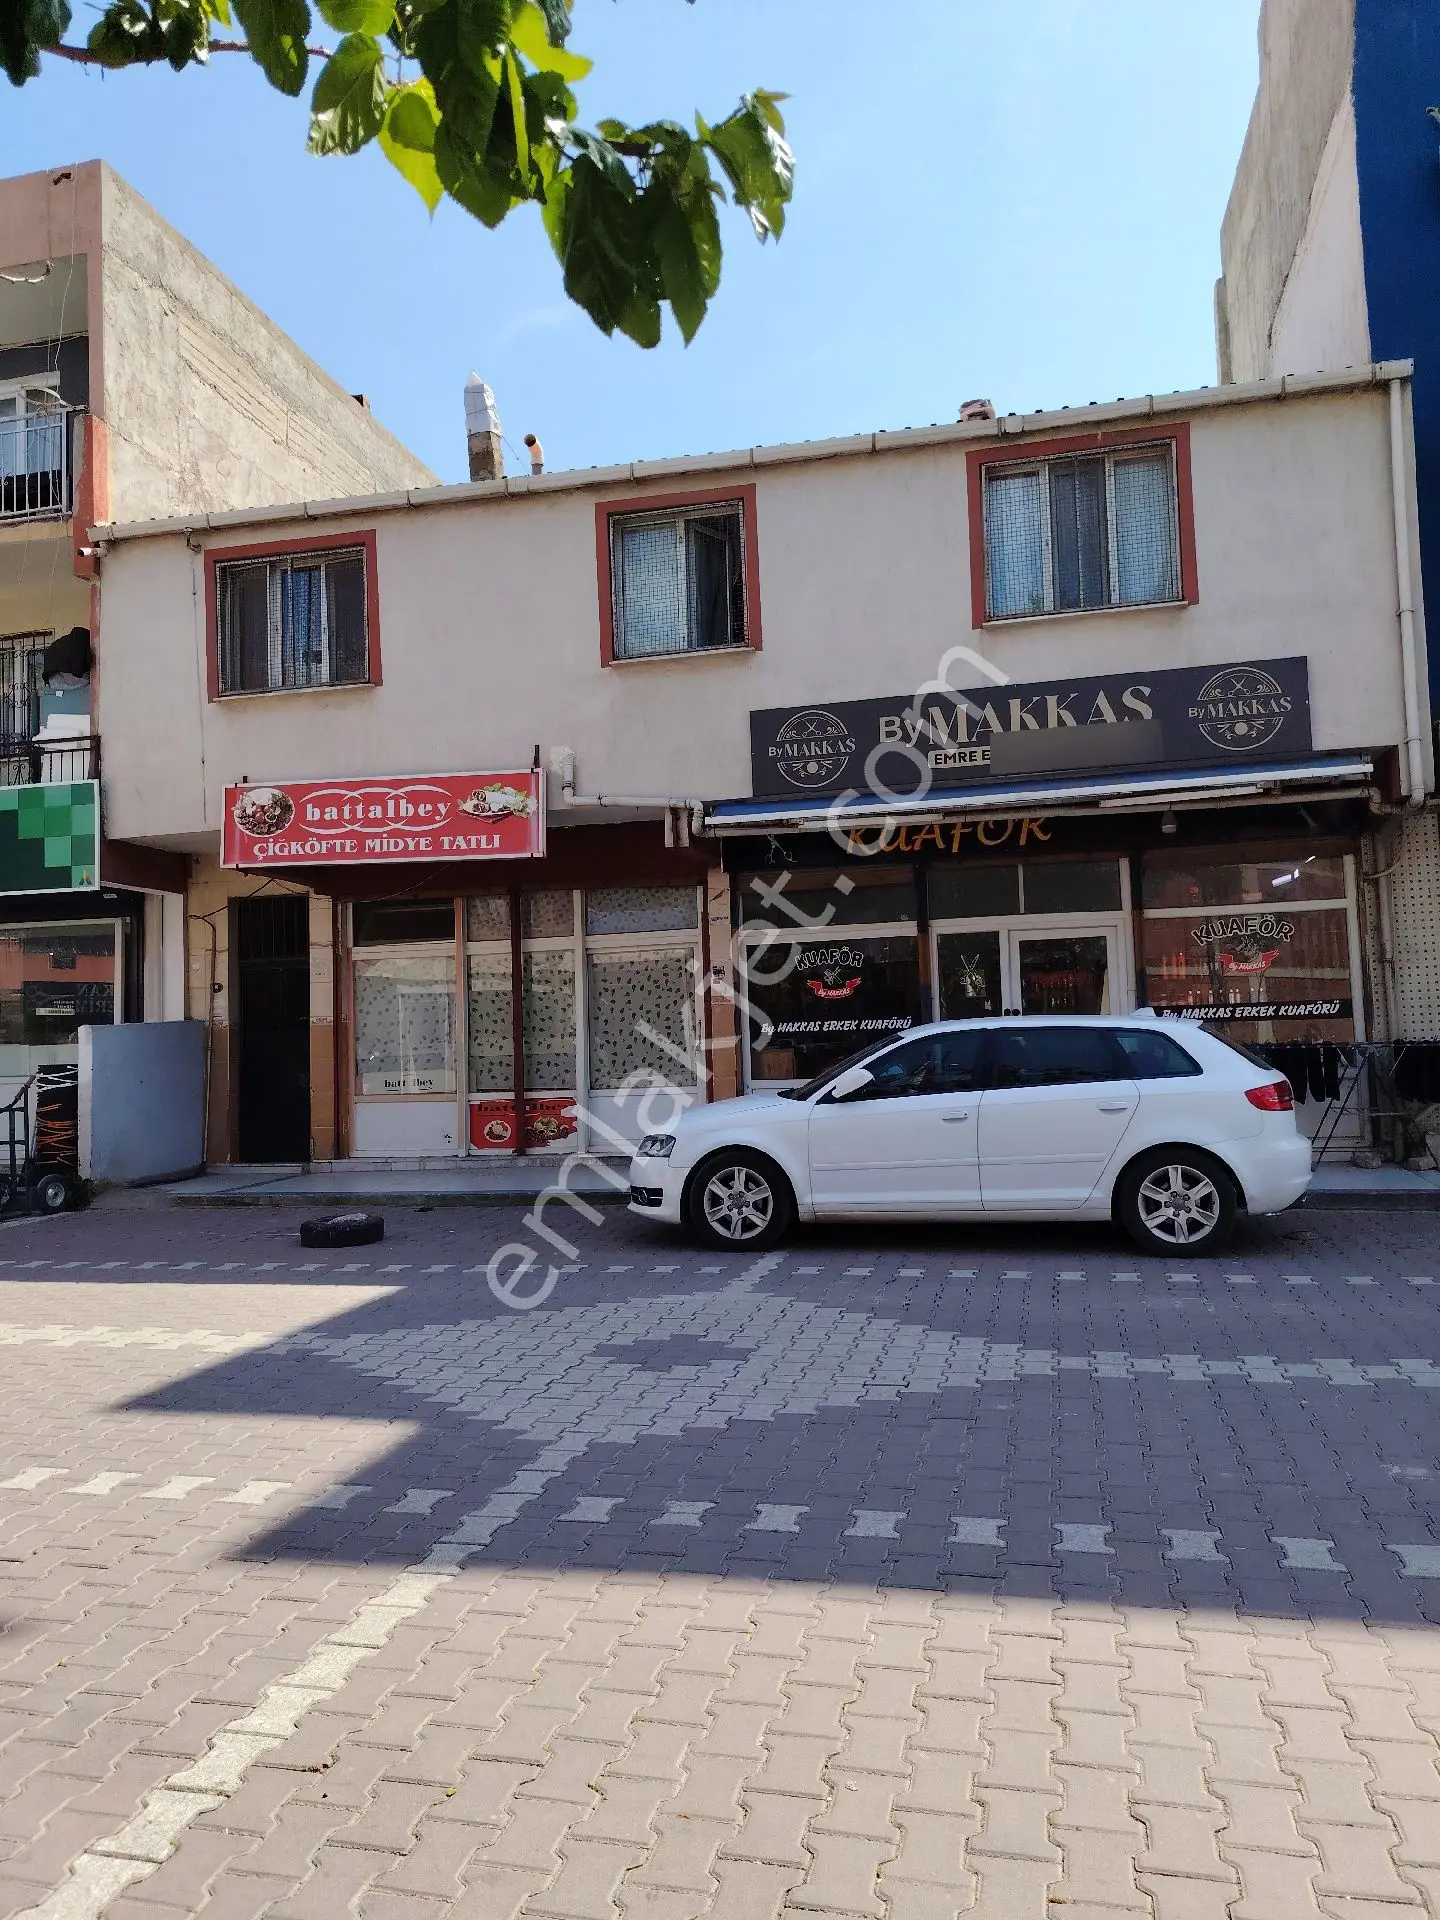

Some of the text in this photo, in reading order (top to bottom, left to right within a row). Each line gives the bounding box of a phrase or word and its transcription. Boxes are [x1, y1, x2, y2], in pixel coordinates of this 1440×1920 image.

[934, 750, 978, 765] EMRE
[305, 798, 452, 822] battalbey
[252, 833, 501, 861] ÇİĞKÖFTE MİDYE TATLI
[1190, 914, 1295, 946] KUAFÖR
[794, 946, 864, 971] KUAFÖR
[1238, 961, 1266, 970] MAKKAS
[1181, 1007, 1232, 1019] MAKKAS
[1235, 1005, 1278, 1018] ERKEK
[1278, 1000, 1340, 1016] KUAFÖRÜ
[761, 1016, 912, 1036] By MAKKAS ERKEK KUAFÖRÜ
[384, 1078, 434, 1090] battlbey
